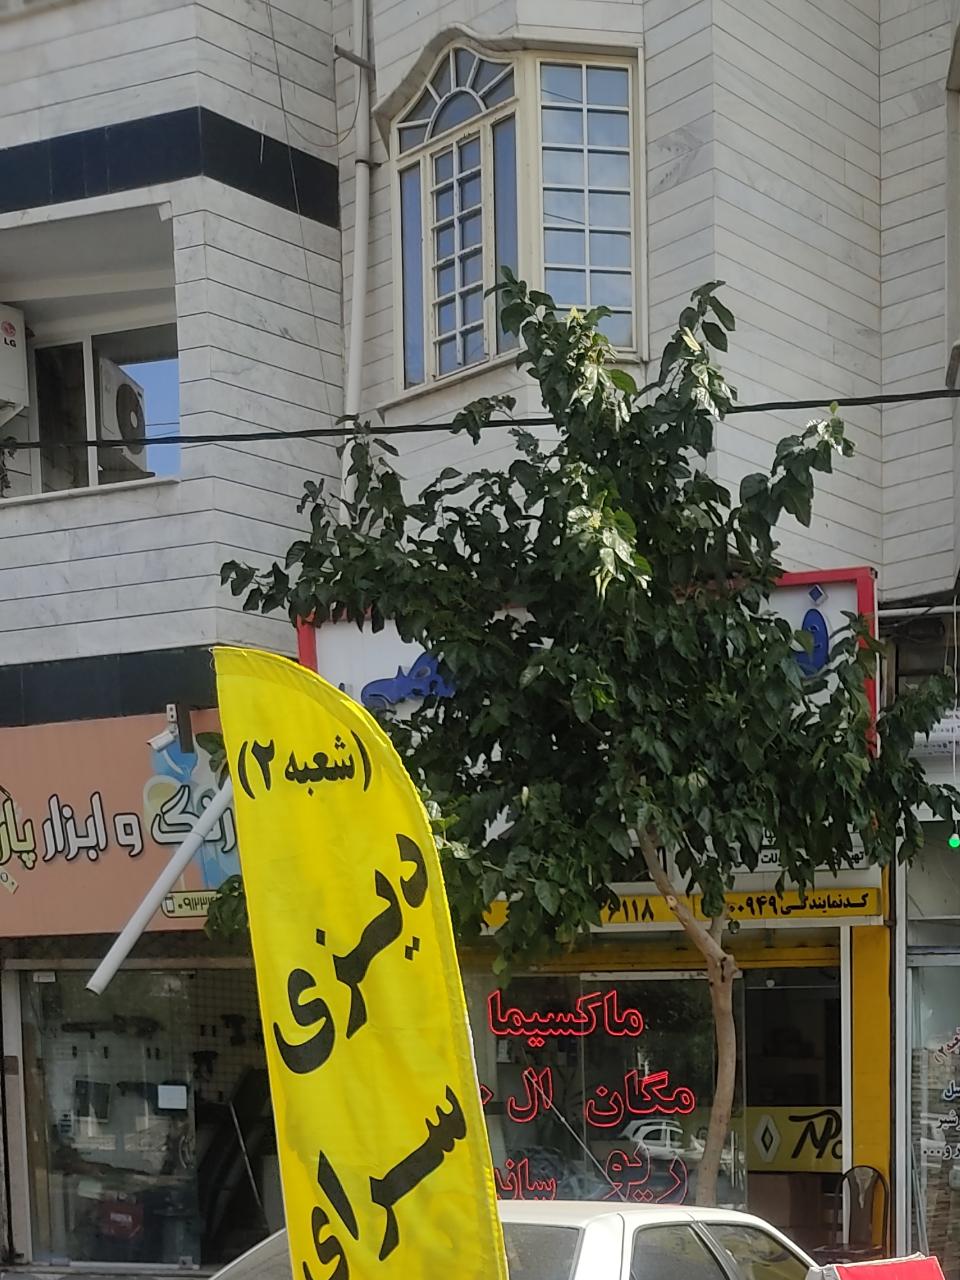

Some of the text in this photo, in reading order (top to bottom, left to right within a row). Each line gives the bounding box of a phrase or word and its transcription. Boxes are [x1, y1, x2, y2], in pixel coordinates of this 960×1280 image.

[4, 337, 17, 348] LG
[42, 790, 108, 863] ابزار
[113, 811, 144, 857] و
[272, 832, 430, 1076] دیزی
[487, 989, 645, 1048] ماکسیما
[584, 1068, 697, 1128] مگان
